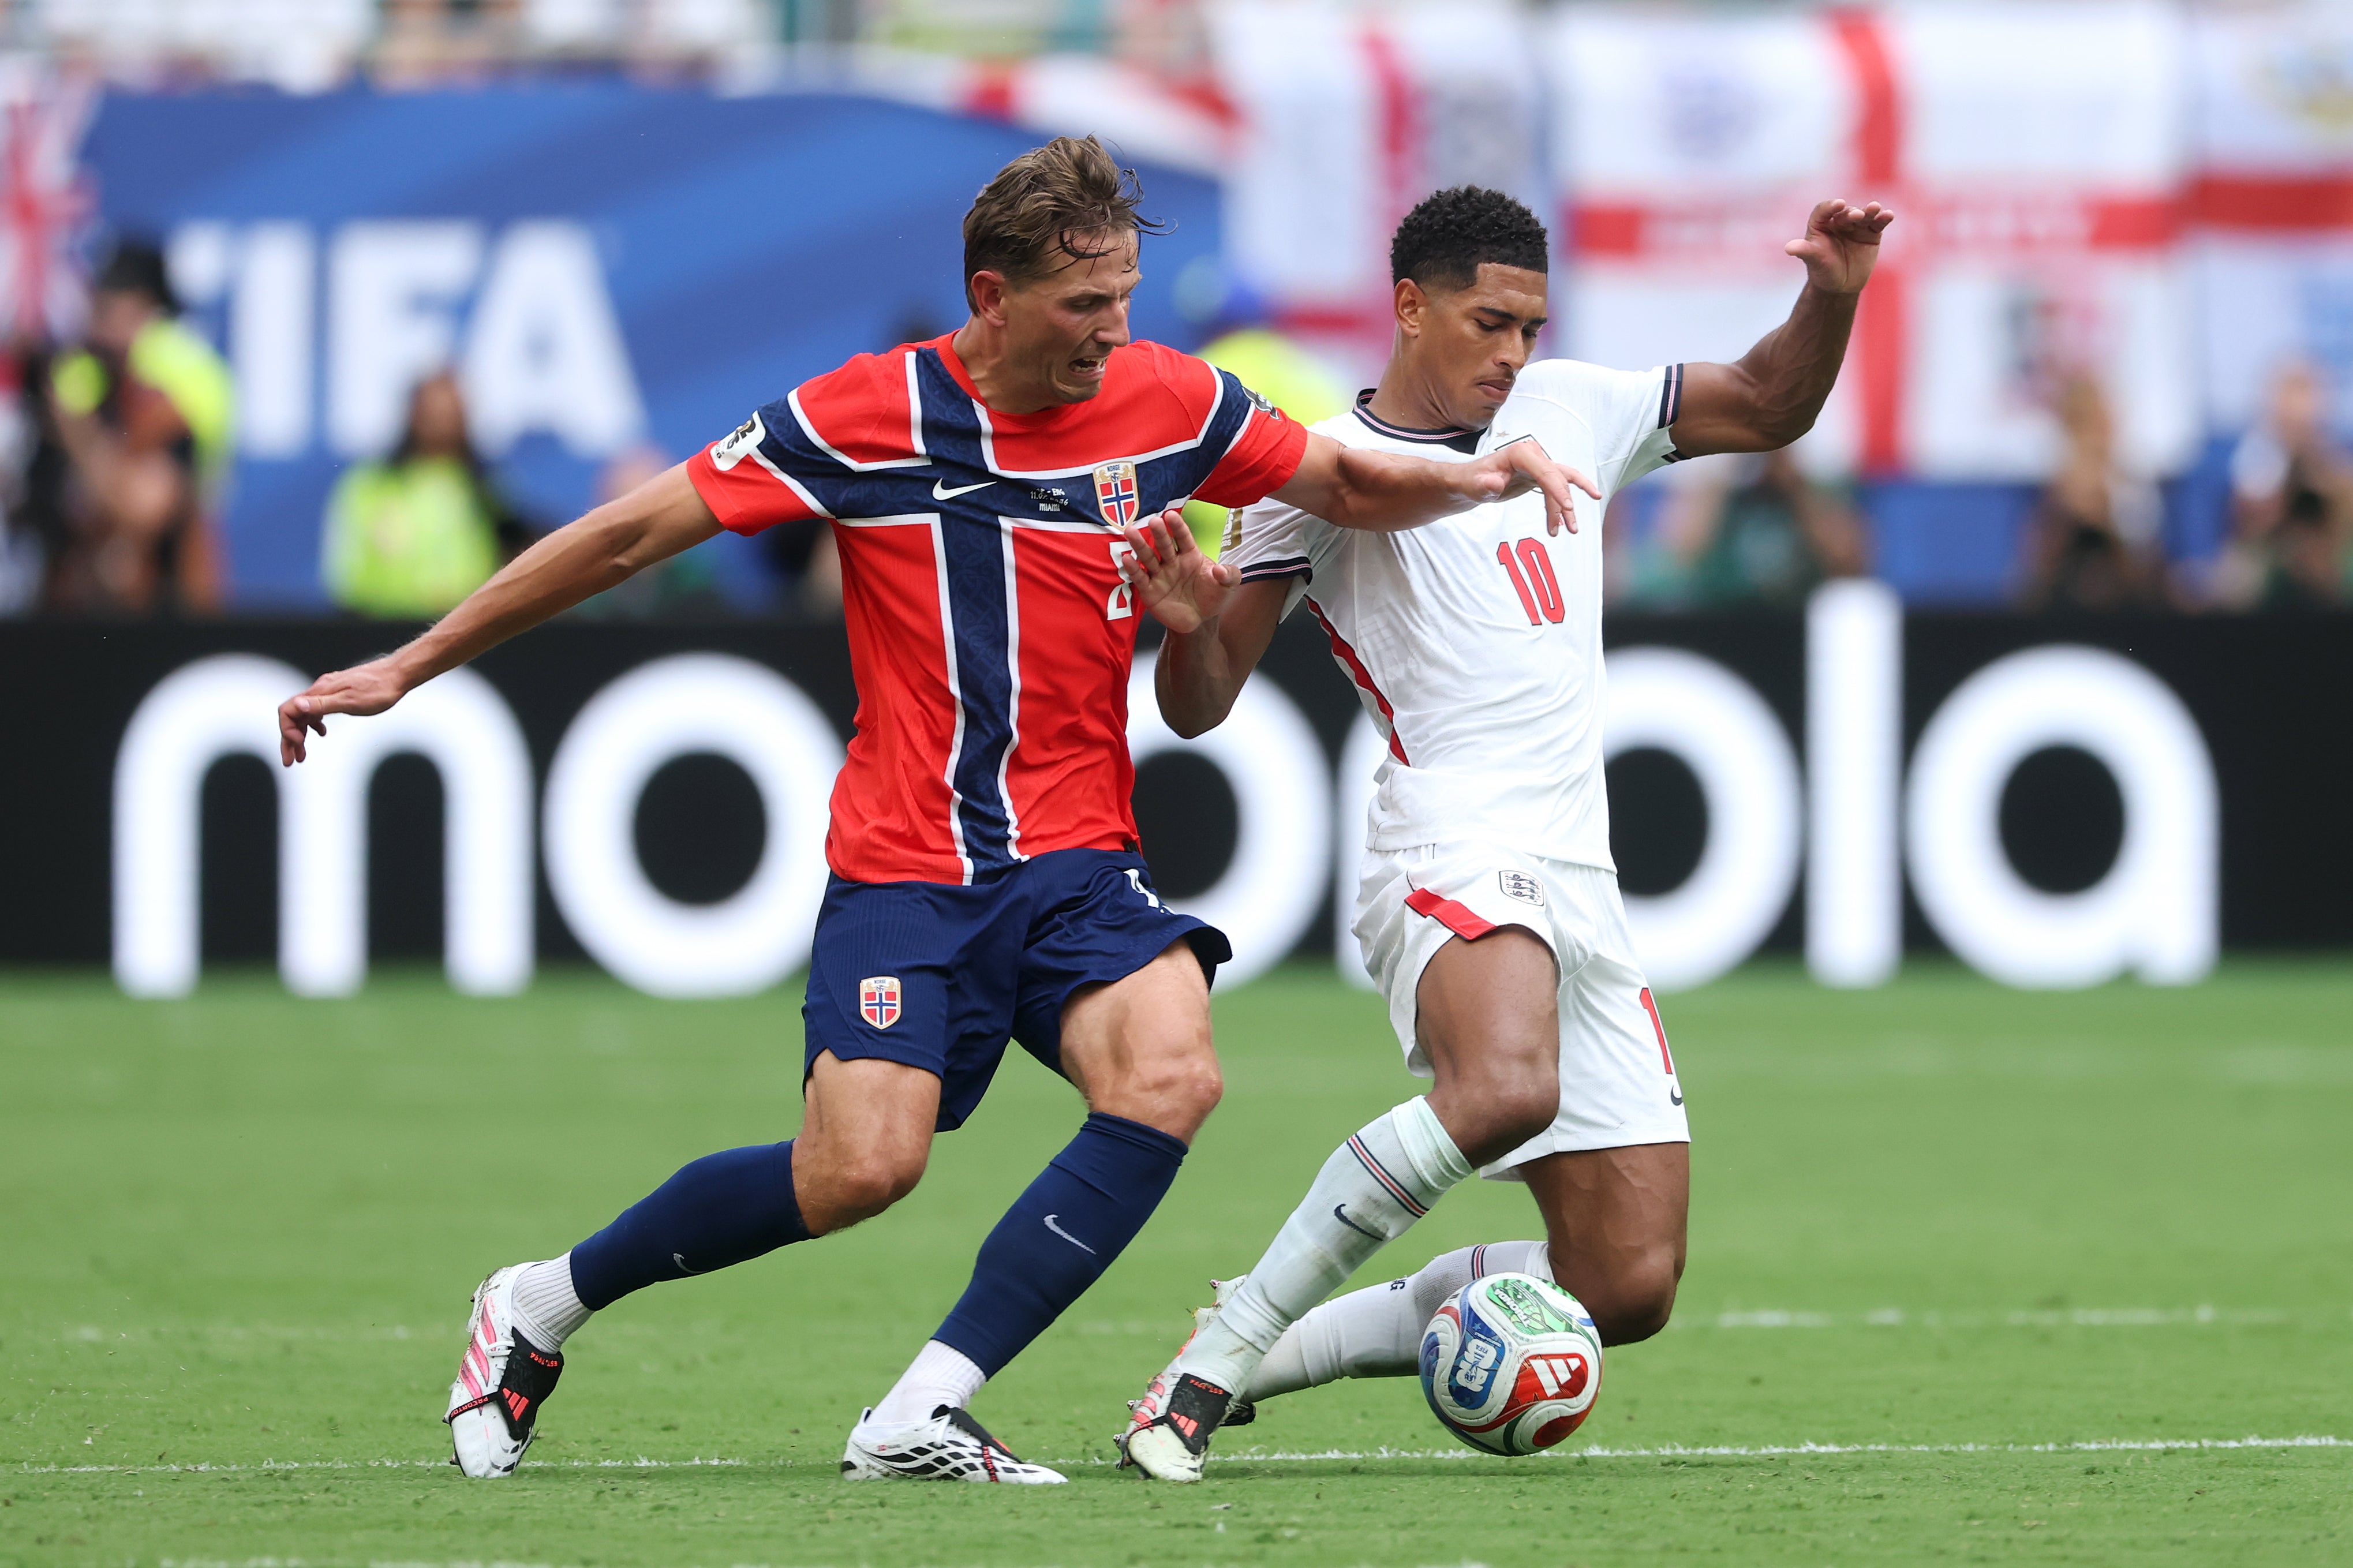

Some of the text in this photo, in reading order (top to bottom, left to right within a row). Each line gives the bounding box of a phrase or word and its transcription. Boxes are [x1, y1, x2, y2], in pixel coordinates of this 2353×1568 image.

[1039, 503, 1060, 512] MIAMI
[1496, 537, 1565, 626] 10
[112, 579, 2220, 1000] mooola
[1494, 1288, 1531, 1329] TRIONDA
[1475, 1344, 1489, 1354] FIFA
